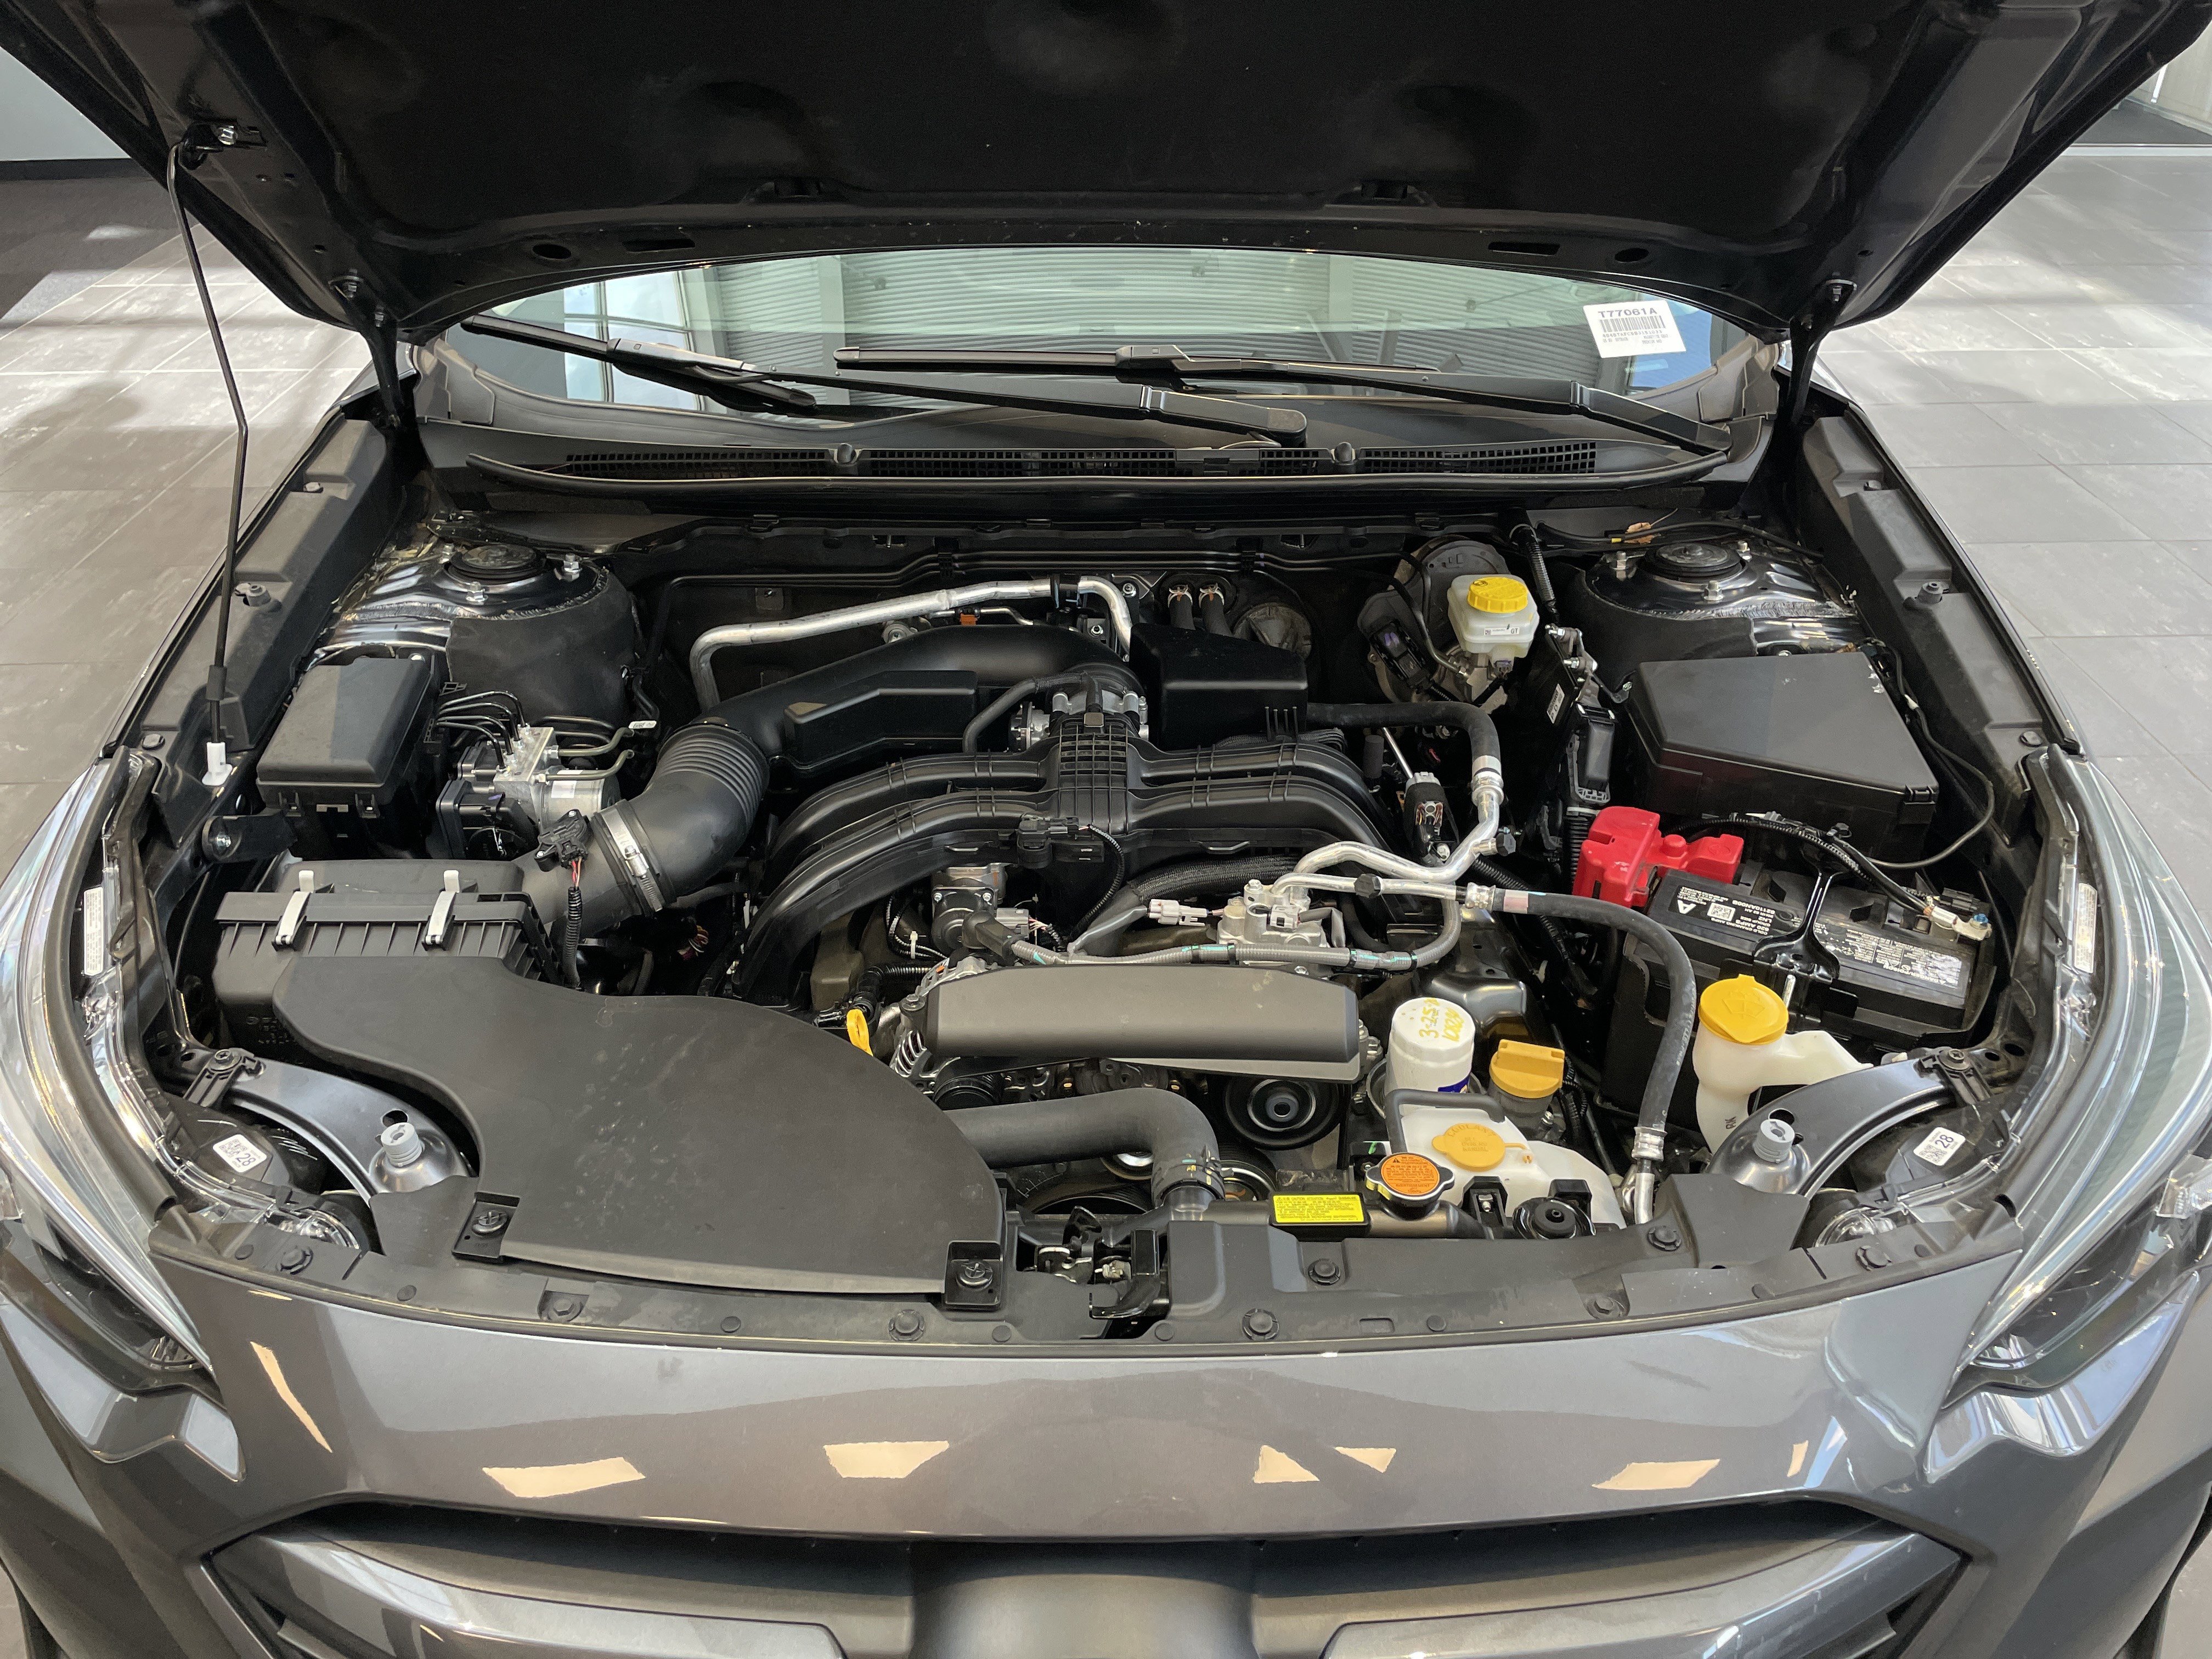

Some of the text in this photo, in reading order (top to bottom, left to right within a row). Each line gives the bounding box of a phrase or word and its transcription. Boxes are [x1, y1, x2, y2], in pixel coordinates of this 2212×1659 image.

[1598, 307, 1657, 318] T77061A
[1726, 921, 1753, 932] CRANKING
[1735, 919, 1757, 928] AMPS
[1935, 1135, 1954, 1148] 28
[236, 1153, 256, 1166] 28
